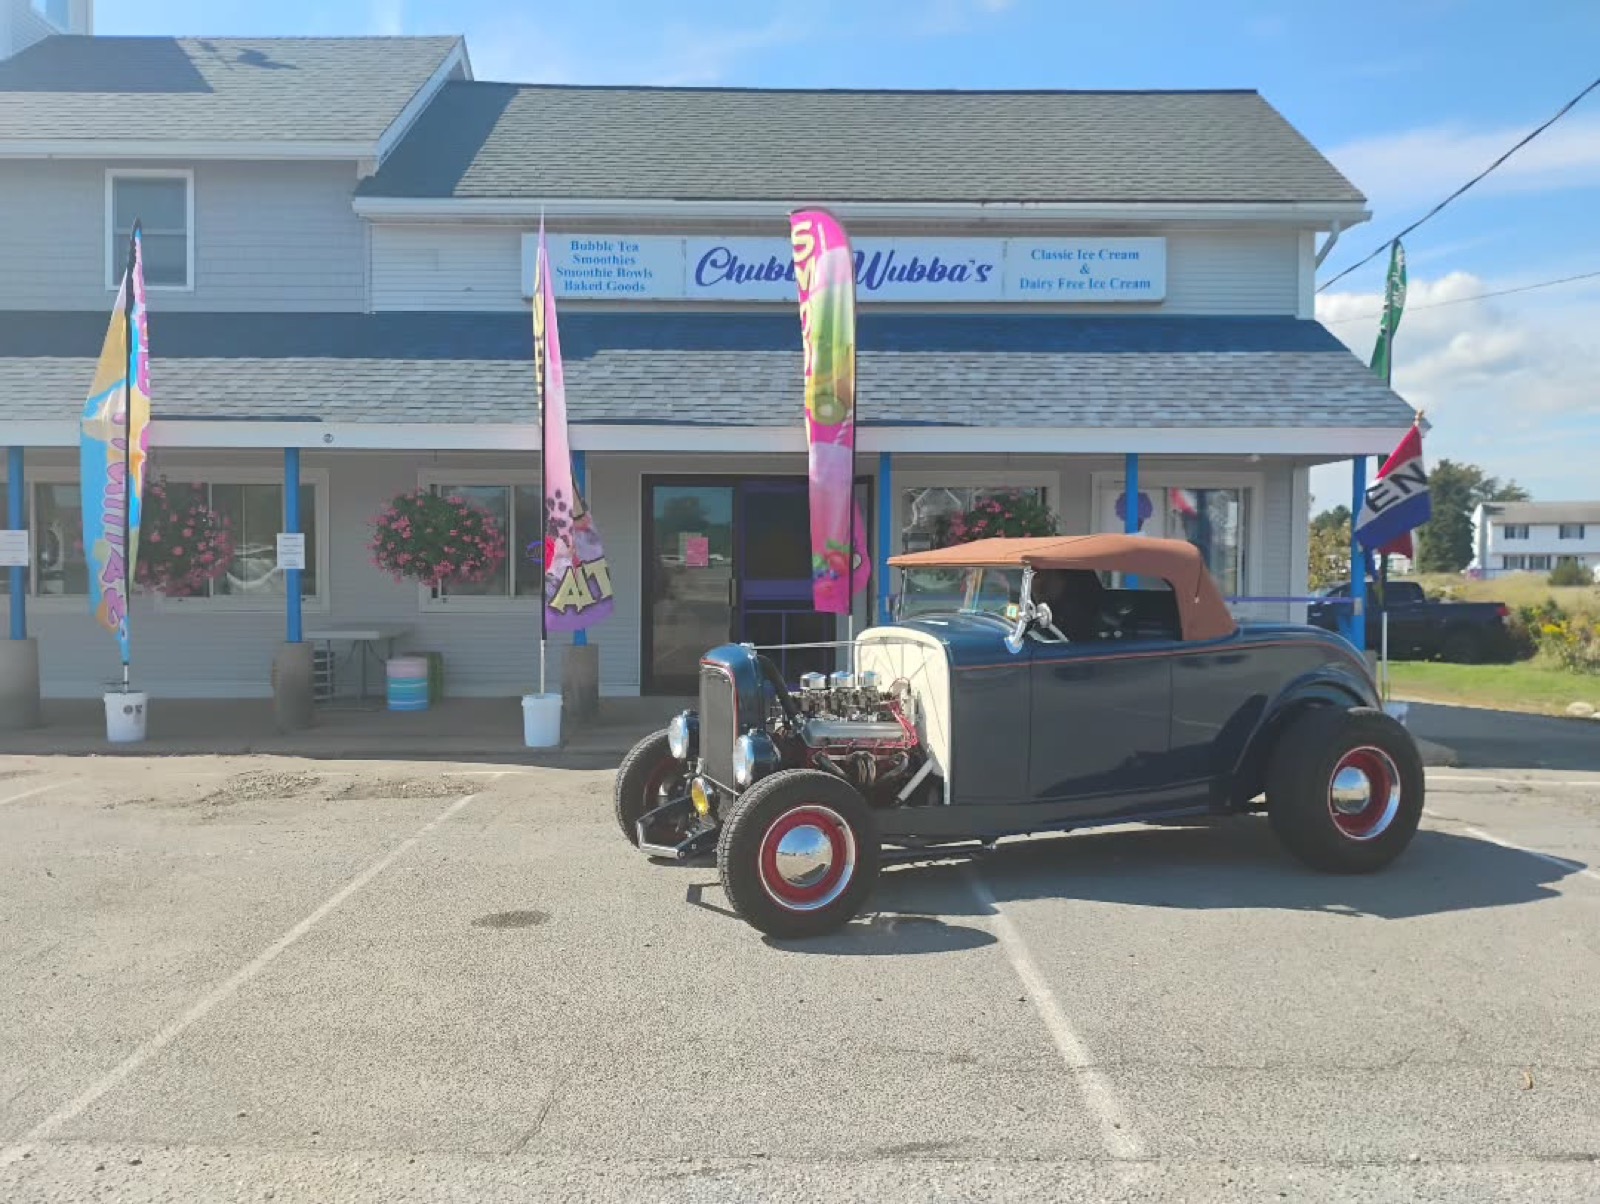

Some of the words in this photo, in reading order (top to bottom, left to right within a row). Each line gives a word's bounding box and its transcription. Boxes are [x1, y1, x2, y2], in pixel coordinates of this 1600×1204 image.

[570, 240, 613, 251] Bubble
[618, 240, 639, 252] Tea
[572, 253, 636, 265] Smoothies
[1031, 248, 1073, 260] Classic
[1077, 249, 1095, 260] Ice
[1098, 249, 1140, 260] Cream
[556, 266, 613, 278] Smoothie
[617, 267, 653, 278] Bowls
[852, 249, 994, 290] Wubba's
[1079, 262, 1091, 275] &
[565, 280, 603, 291] Baked
[606, 281, 646, 292] Goods
[1019, 277, 1054, 292] Dairy
[1058, 278, 1086, 290] Free
[1089, 278, 1106, 290] Ice
[1110, 278, 1151, 290] Cream
